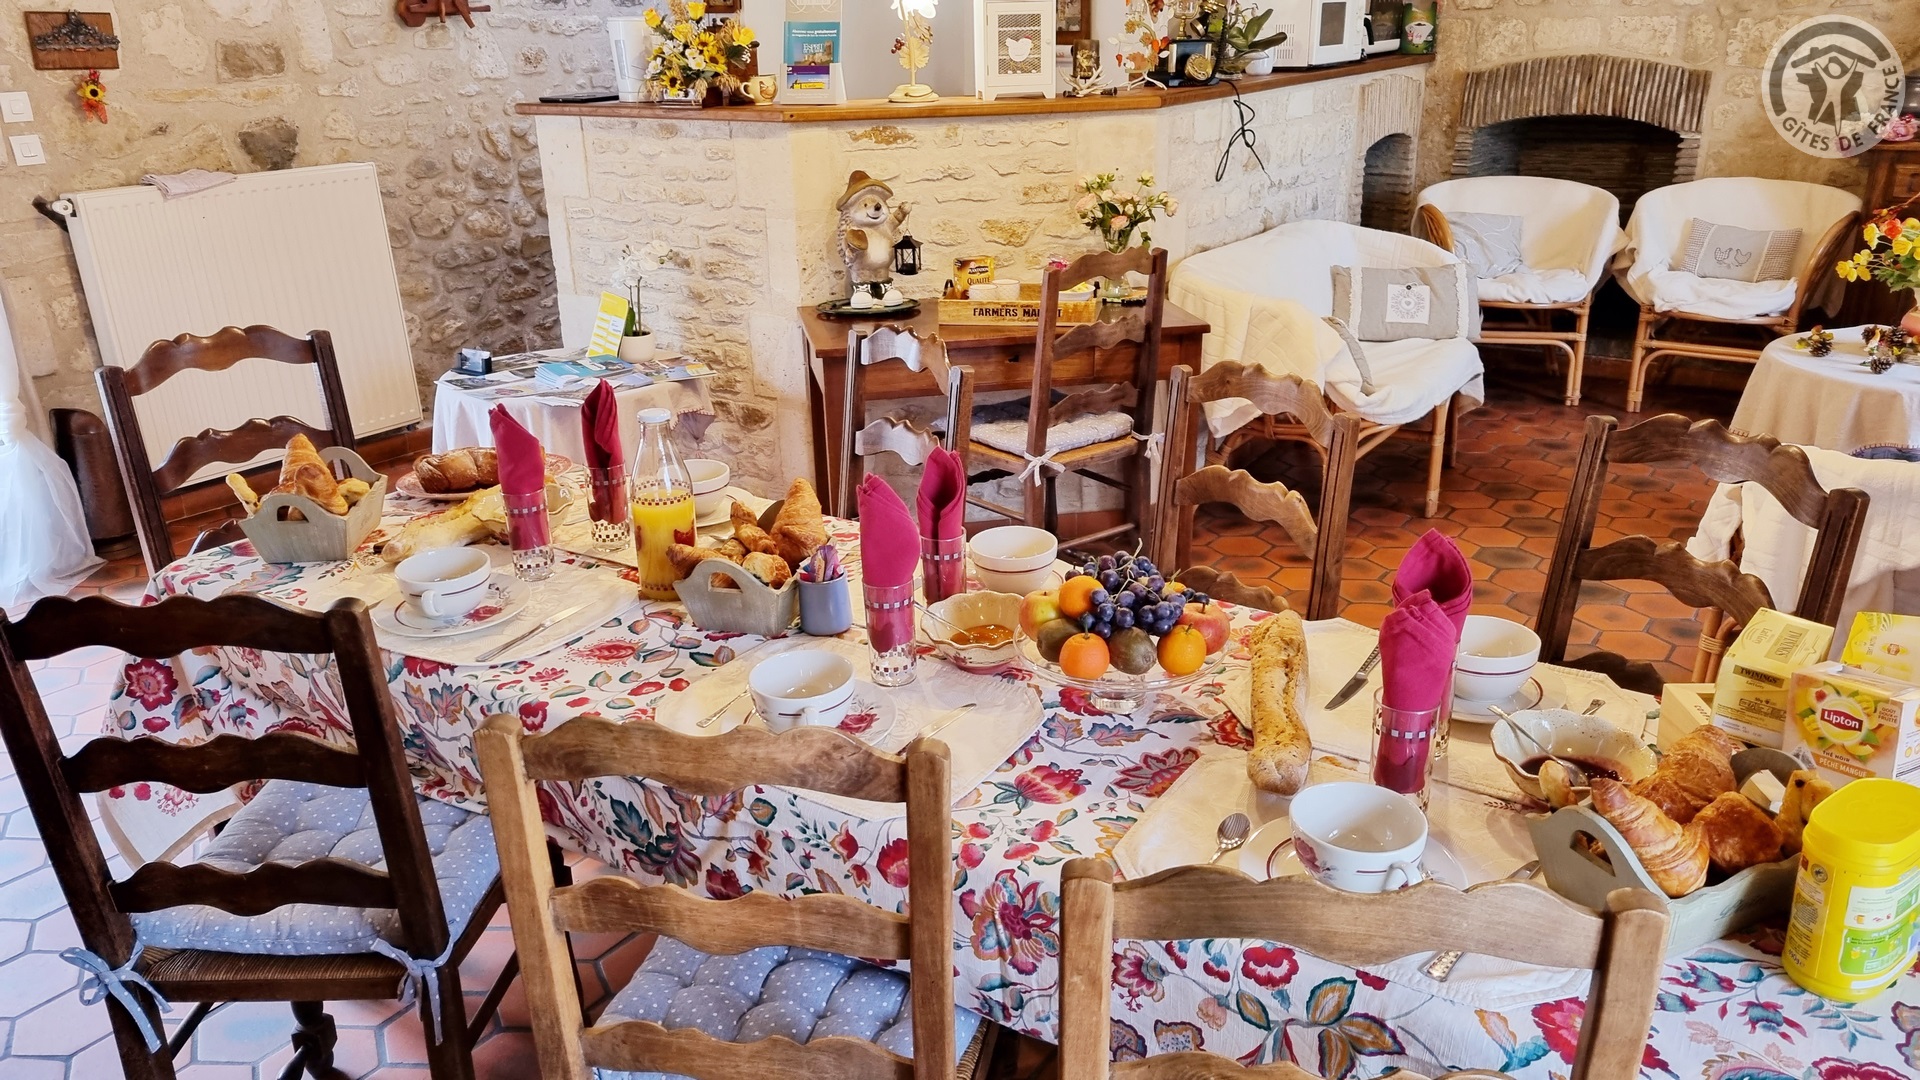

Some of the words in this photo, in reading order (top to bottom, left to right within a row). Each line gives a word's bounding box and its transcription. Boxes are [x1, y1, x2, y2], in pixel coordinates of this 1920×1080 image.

[973, 307, 1018, 317] FARMERS
[1022, 308, 1063, 318] MAT
[1739, 666, 1778, 684] TWININGS
[1824, 711, 1860, 730] Lipton
[1822, 749, 1834, 758] THÉ
[1834, 753, 1850, 762] NOIR
[1819, 757, 1838, 769] PÊCHE
[1839, 764, 1868, 778] MANGUE
